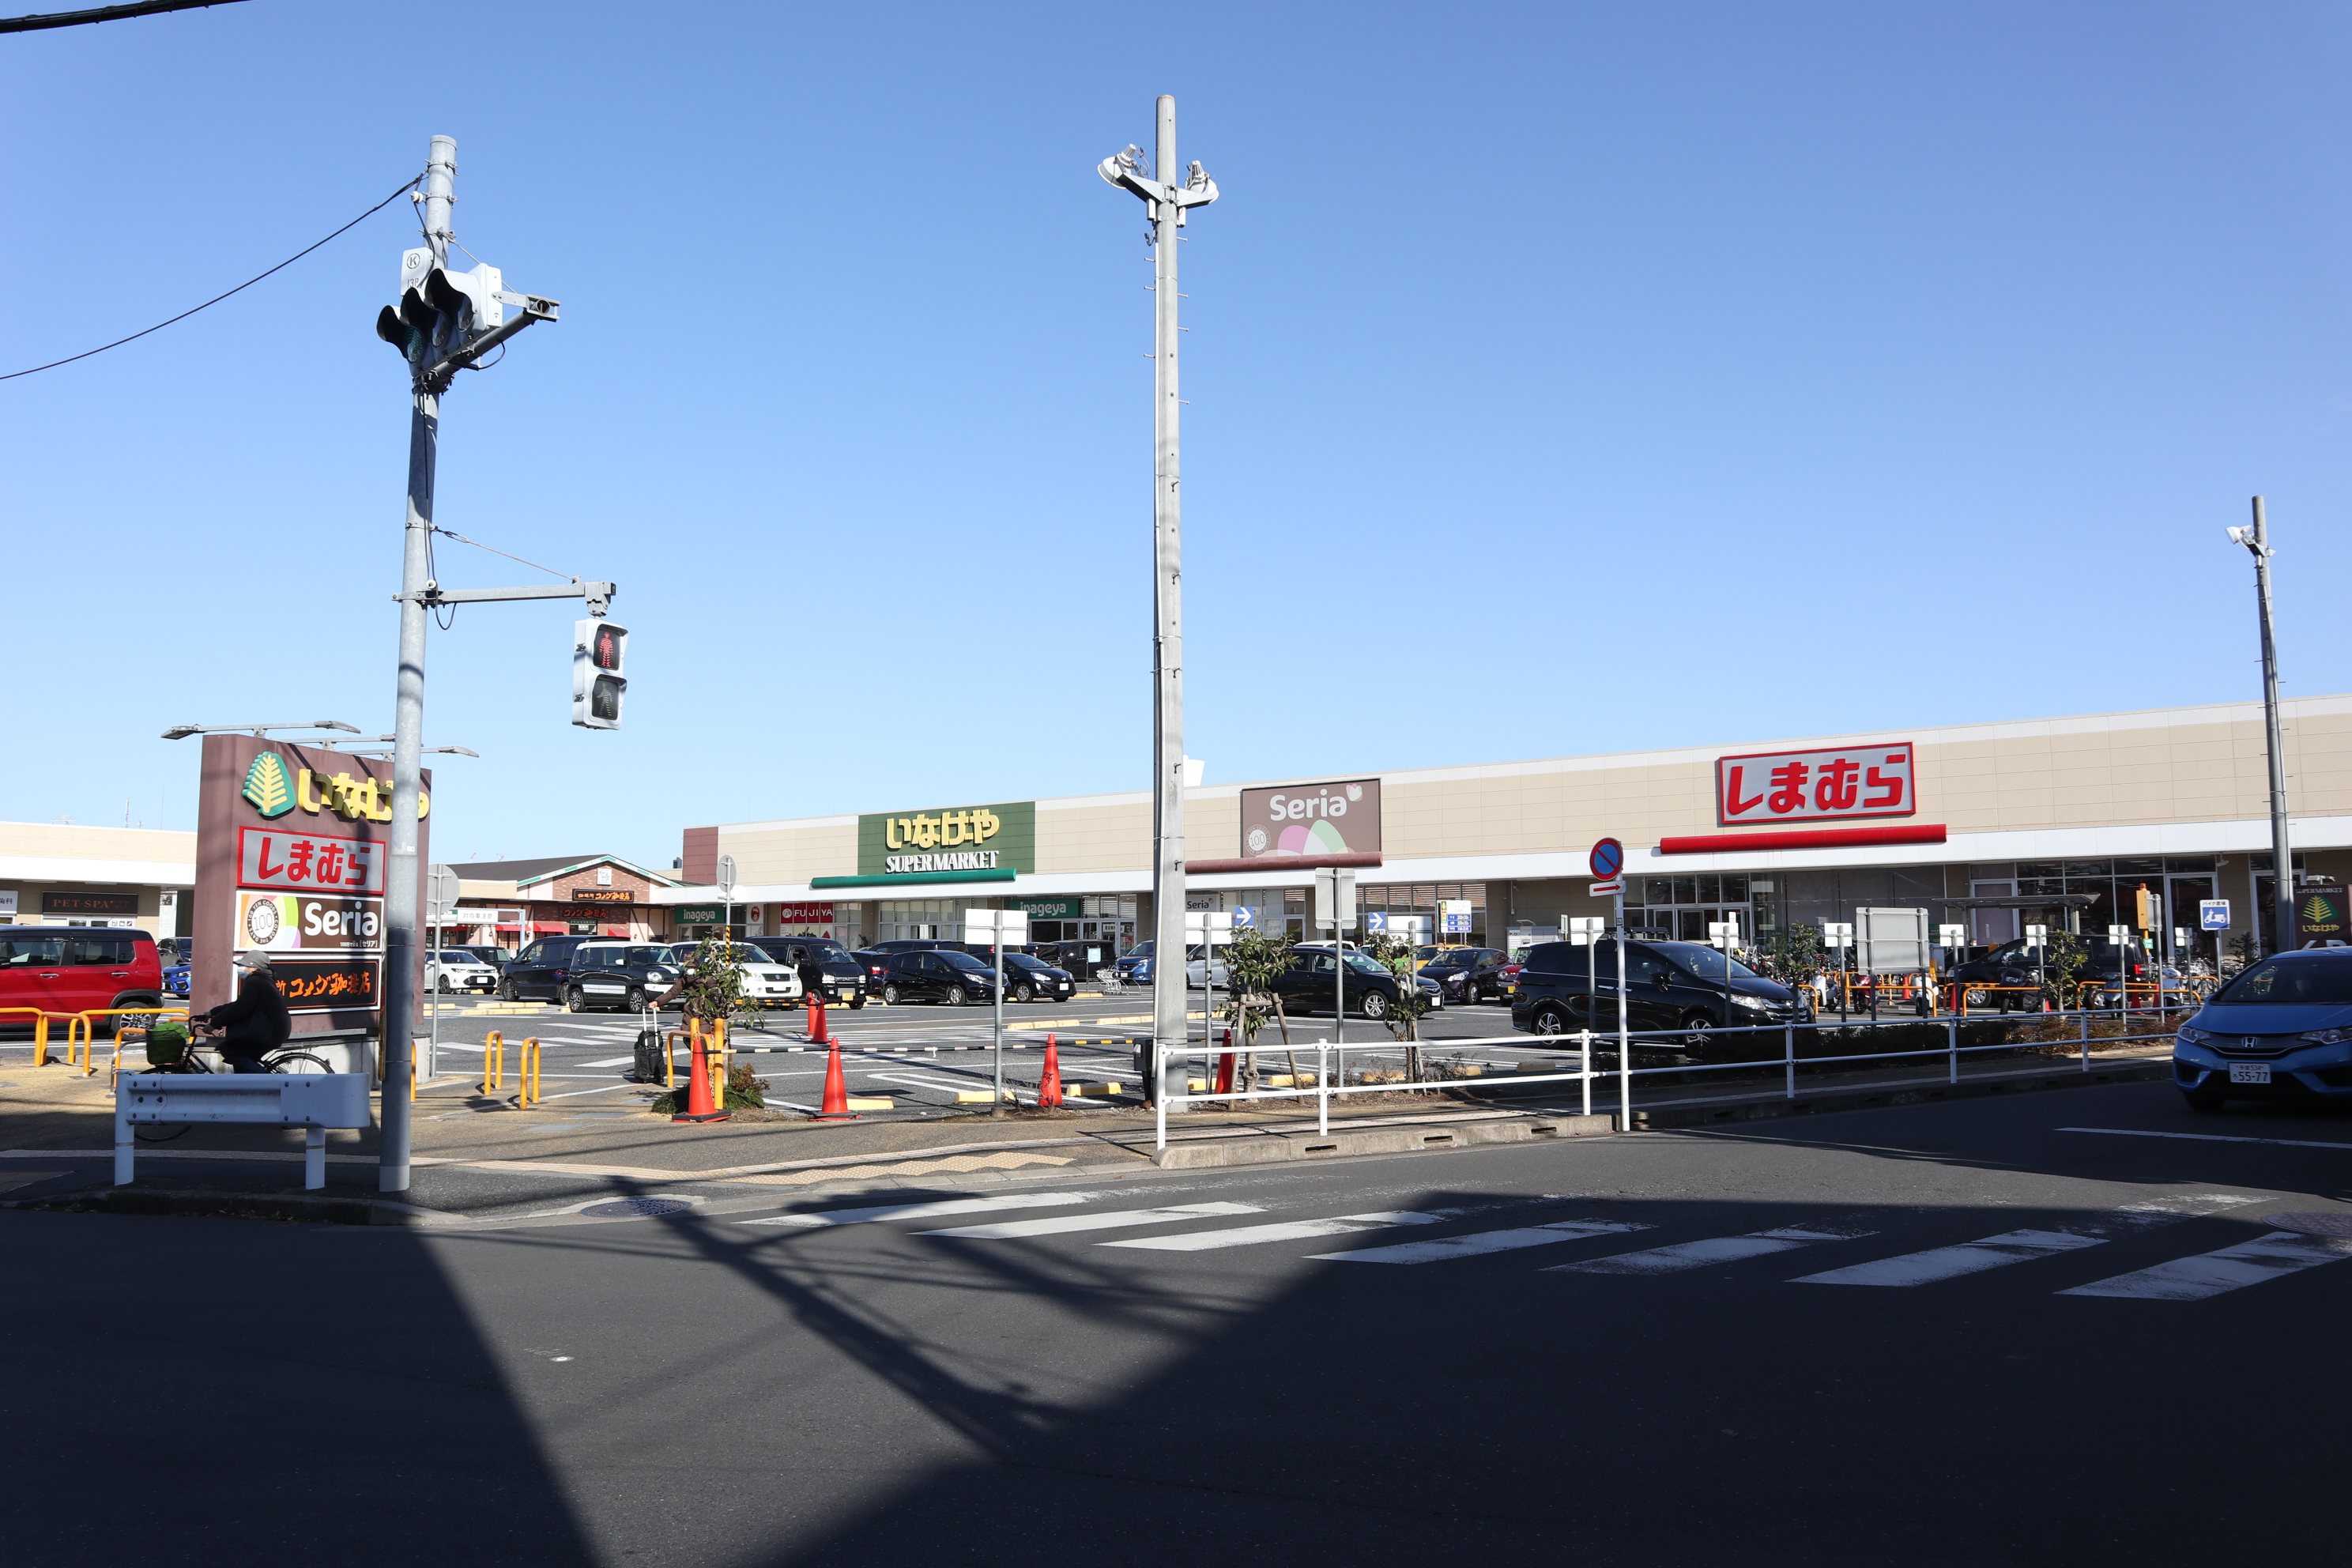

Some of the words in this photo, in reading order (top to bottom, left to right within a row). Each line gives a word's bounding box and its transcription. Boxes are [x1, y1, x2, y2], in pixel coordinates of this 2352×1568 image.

[1727, 753, 1906, 815] しまむら
[1269, 788, 1348, 821] Seria
[886, 808, 1001, 850] いなげや
[1249, 833, 1265, 847] 100
[258, 835, 371, 887] しまむら
[1186, 899, 1209, 910] Seria
[253, 912, 273, 932] 100
[304, 901, 379, 937] Seria
[683, 909, 716, 922] inageya
[2302, 923, 2340, 933] いなげや
[2238, 1071, 2268, 1082] 55-77
